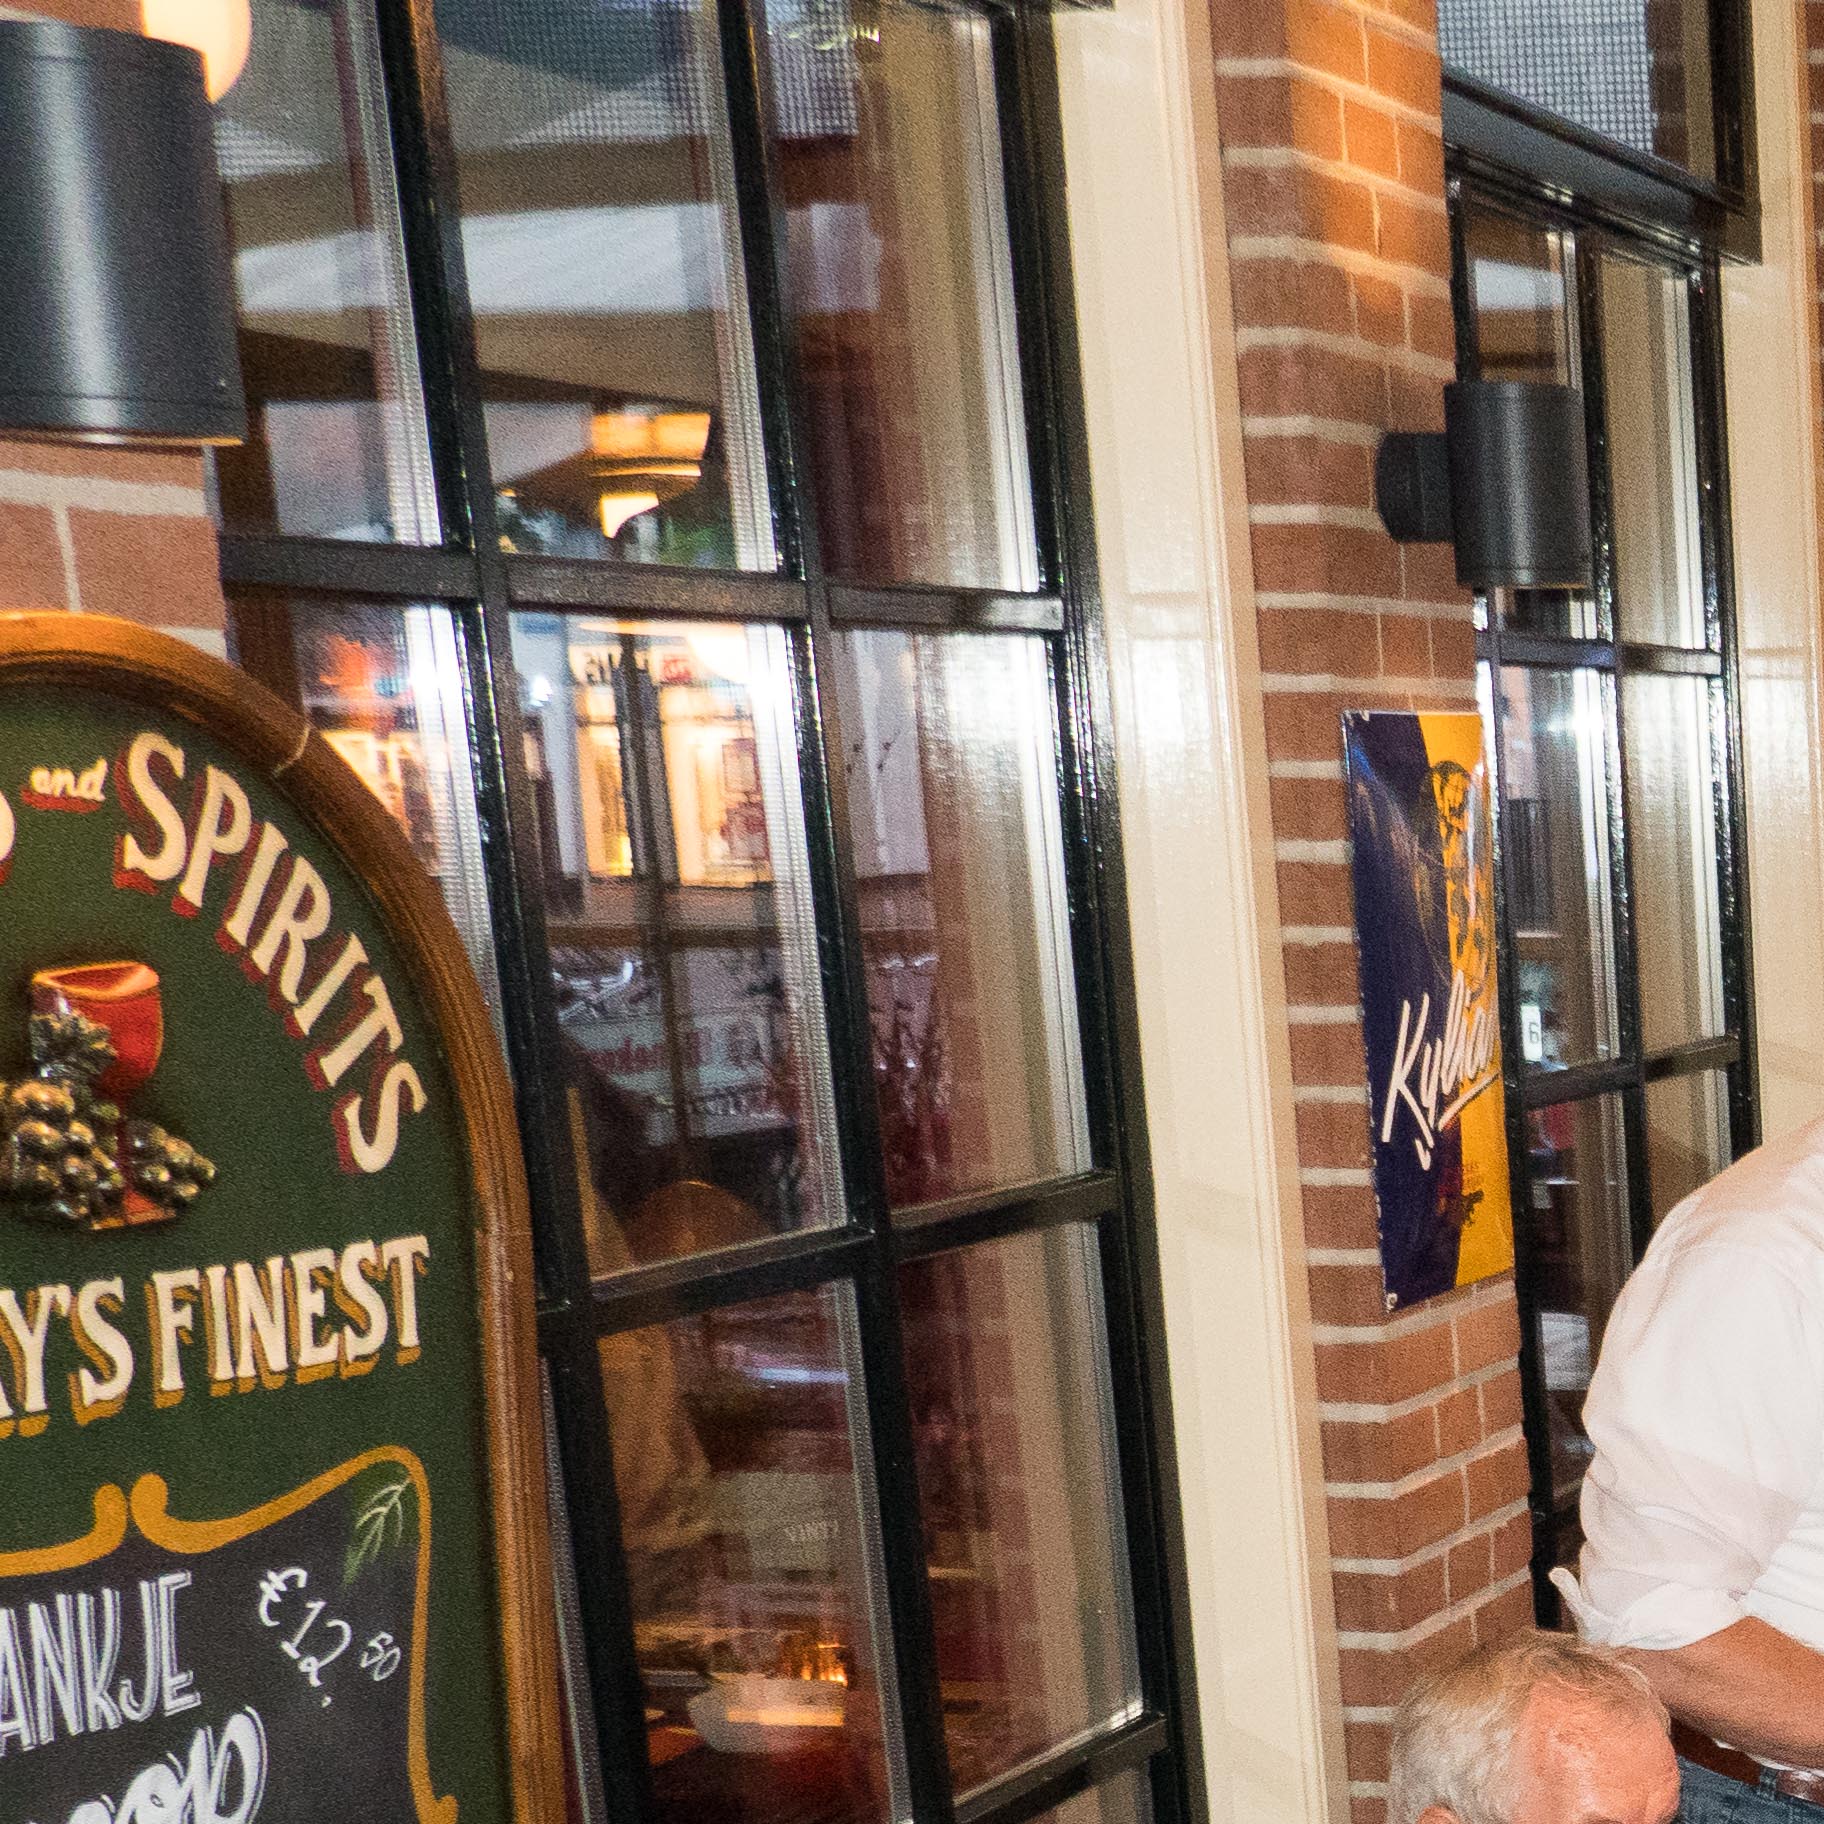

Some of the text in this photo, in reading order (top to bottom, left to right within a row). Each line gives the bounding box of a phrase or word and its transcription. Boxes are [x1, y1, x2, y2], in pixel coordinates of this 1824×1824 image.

[29, 730, 428, 1175] and SPIRITS
[151, 1233, 430, 1391] FINEST
